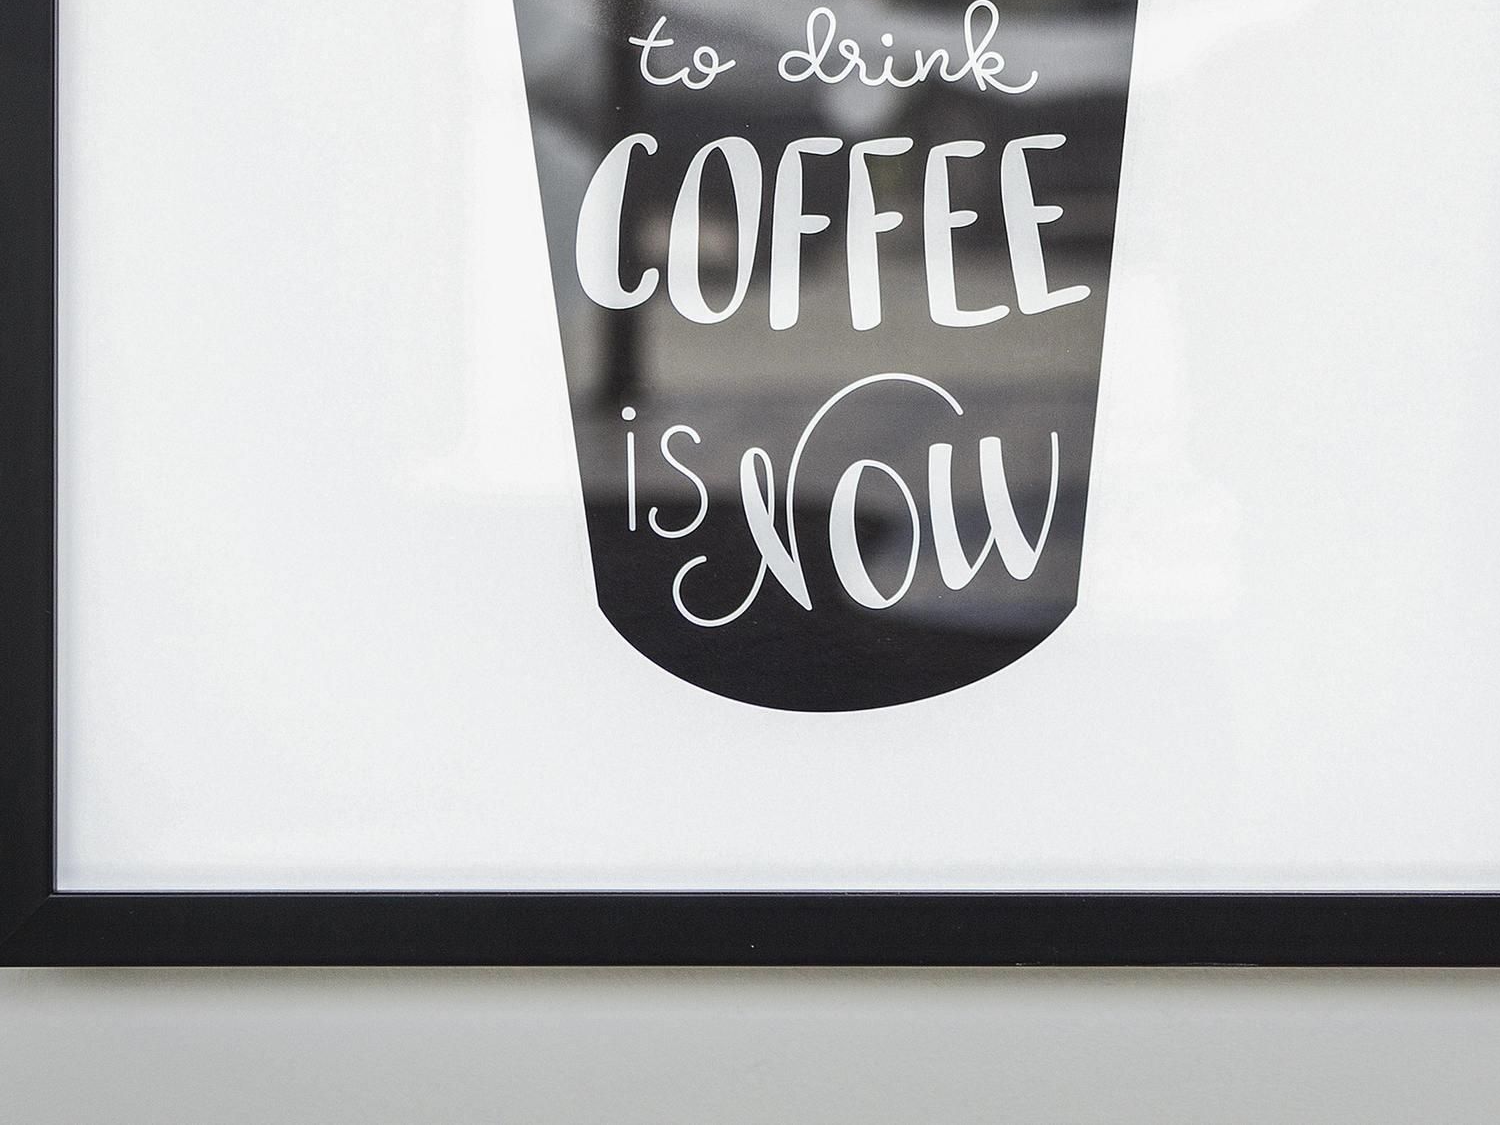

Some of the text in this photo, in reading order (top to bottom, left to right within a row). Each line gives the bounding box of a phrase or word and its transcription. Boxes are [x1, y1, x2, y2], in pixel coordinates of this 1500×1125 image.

[628, 0, 1039, 95] to drink
[575, 133, 1091, 331] COFFEE
[620, 405, 709, 539] is
